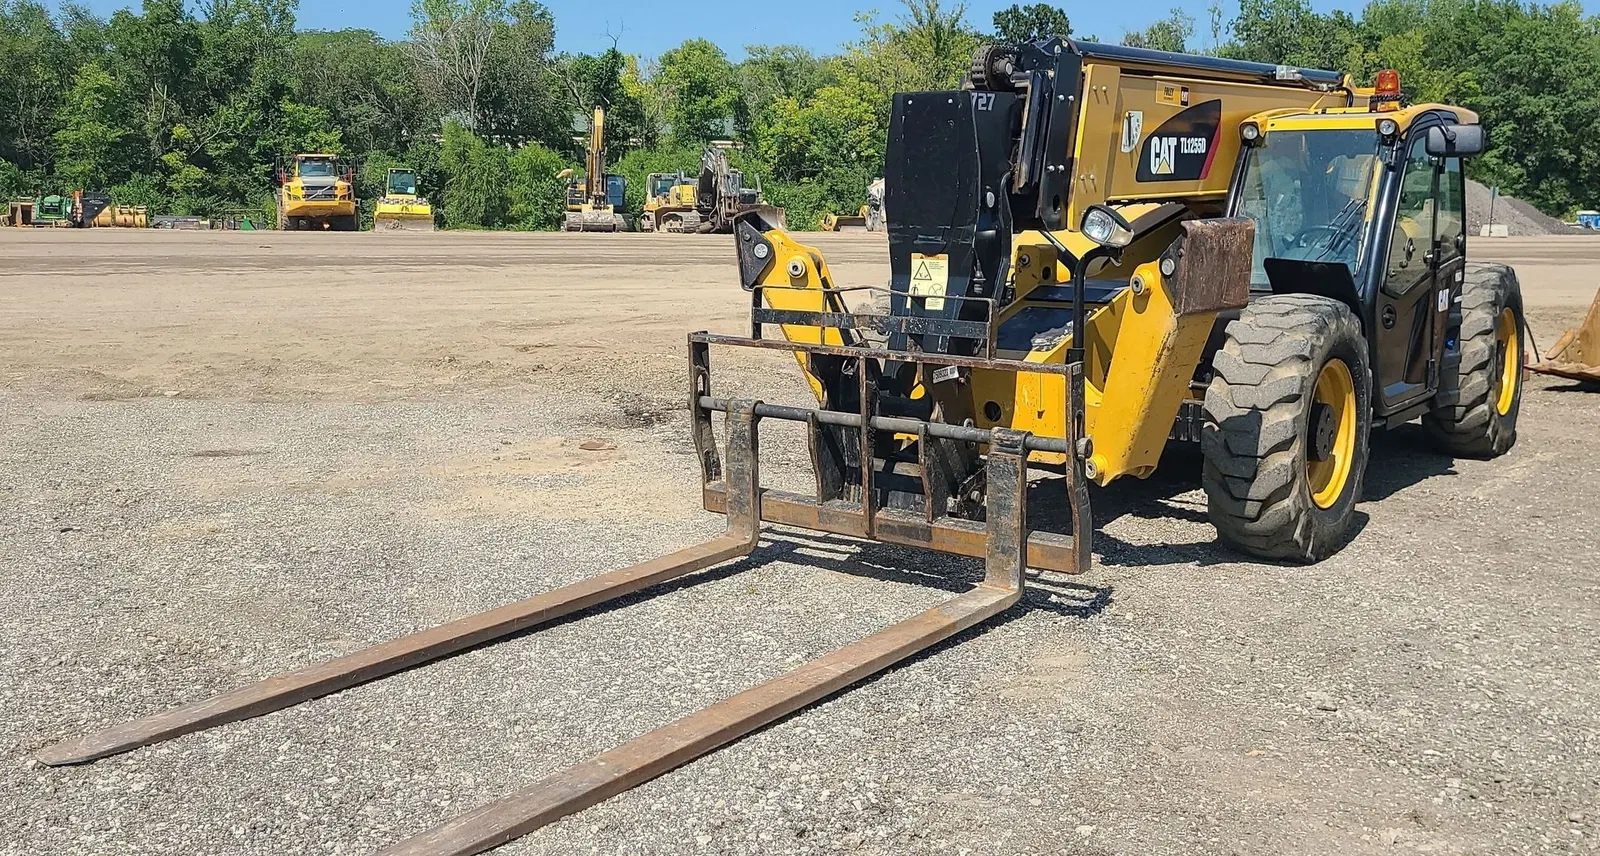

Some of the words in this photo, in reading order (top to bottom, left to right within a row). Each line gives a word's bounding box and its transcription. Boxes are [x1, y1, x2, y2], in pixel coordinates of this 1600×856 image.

[971, 92, 996, 111] 727
[1150, 136, 1177, 175] CAT
[1180, 137, 1207, 154] TL1255D
